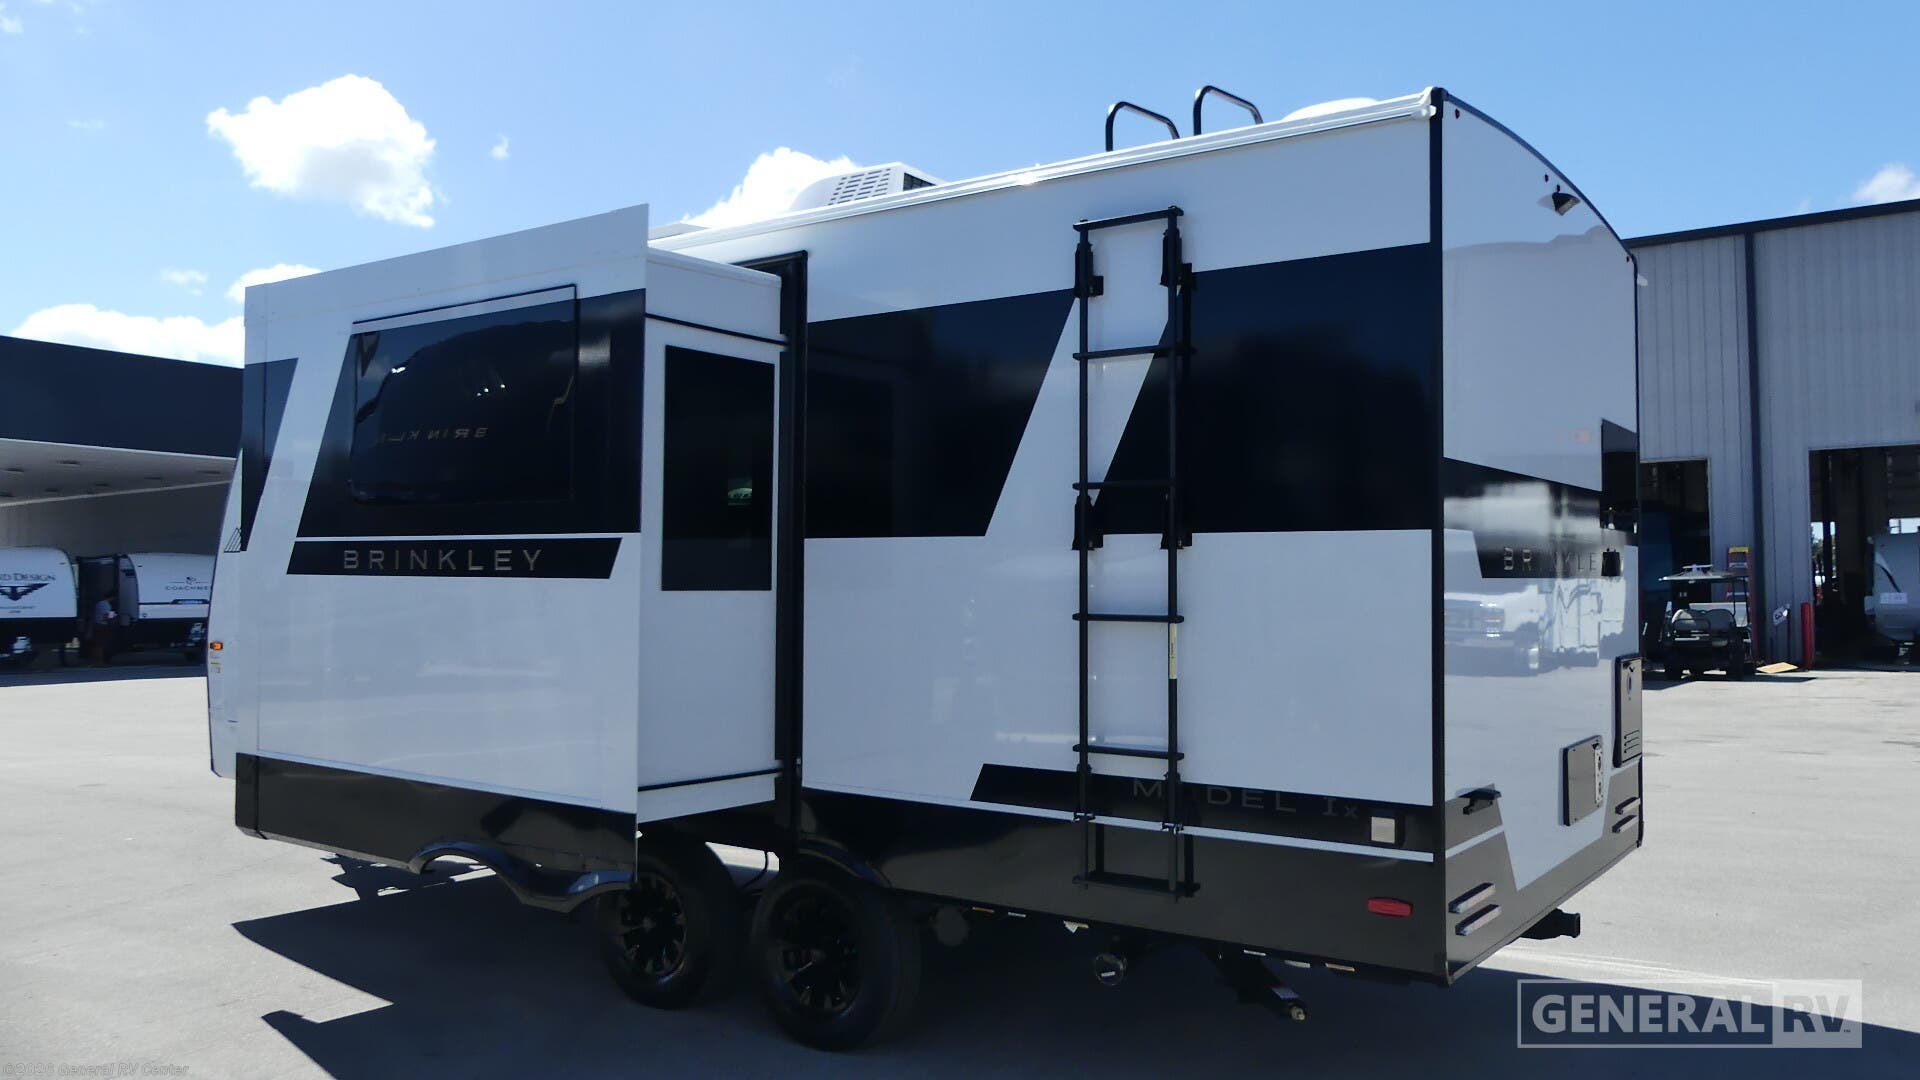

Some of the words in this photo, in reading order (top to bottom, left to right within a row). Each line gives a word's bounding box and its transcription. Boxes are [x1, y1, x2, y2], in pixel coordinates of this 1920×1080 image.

[343, 549, 542, 571] BRINKLEY
[13, 572, 56, 581] DESIGN
[1132, 778, 1296, 812] MDEL
